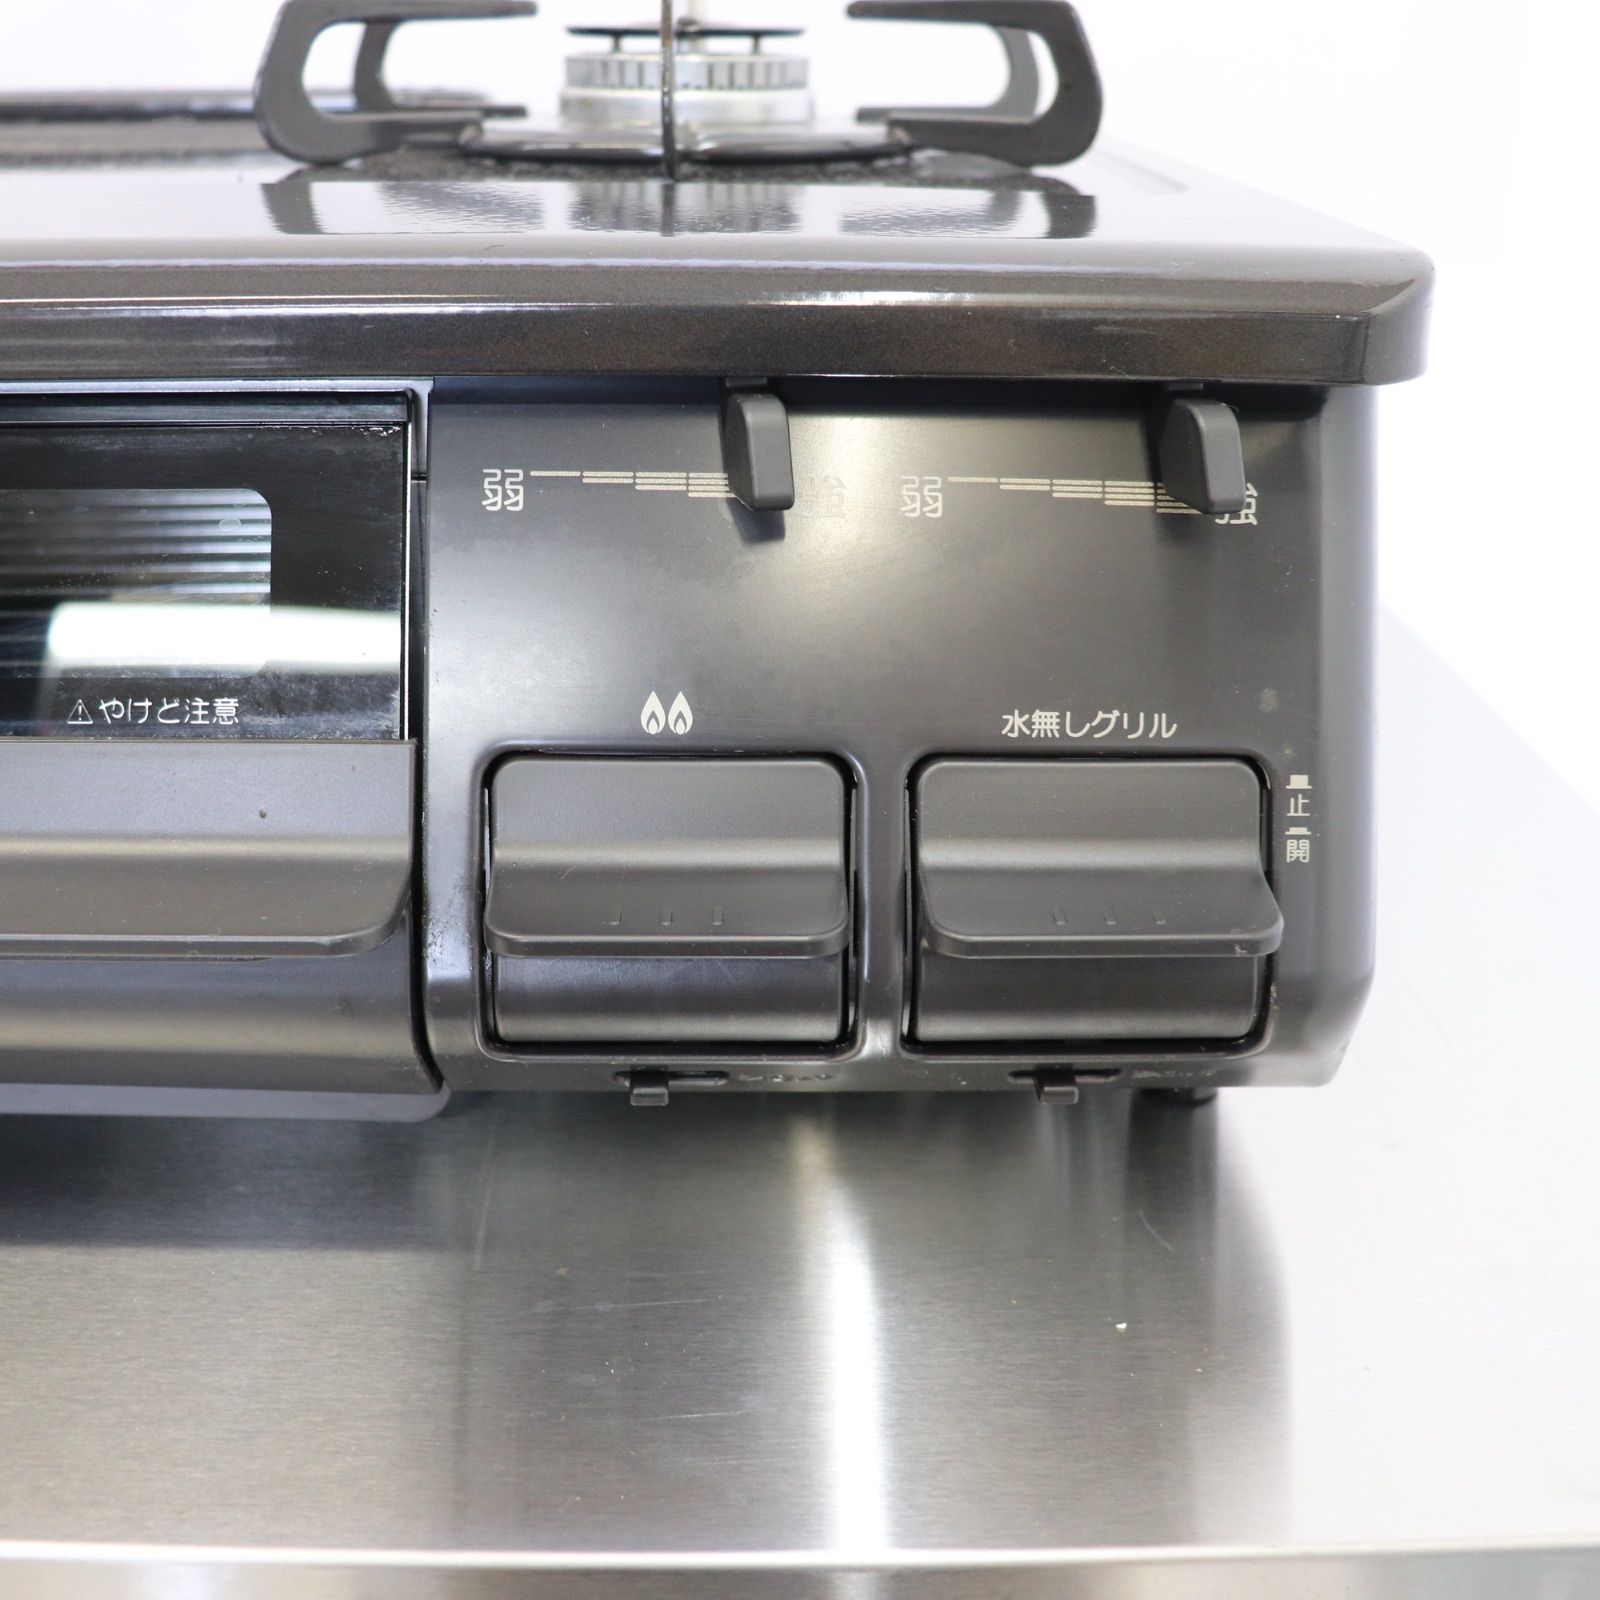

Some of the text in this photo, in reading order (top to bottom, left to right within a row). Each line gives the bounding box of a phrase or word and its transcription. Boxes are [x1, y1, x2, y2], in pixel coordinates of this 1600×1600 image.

[482, 468, 523, 511] 弱
[901, 475, 943, 518] 弱
[99, 697, 239, 725] やけど注意
[1001, 709, 1178, 739] 水無しグリル
[1286, 794, 1310, 817] 止
[1286, 839, 1310, 863] 開
